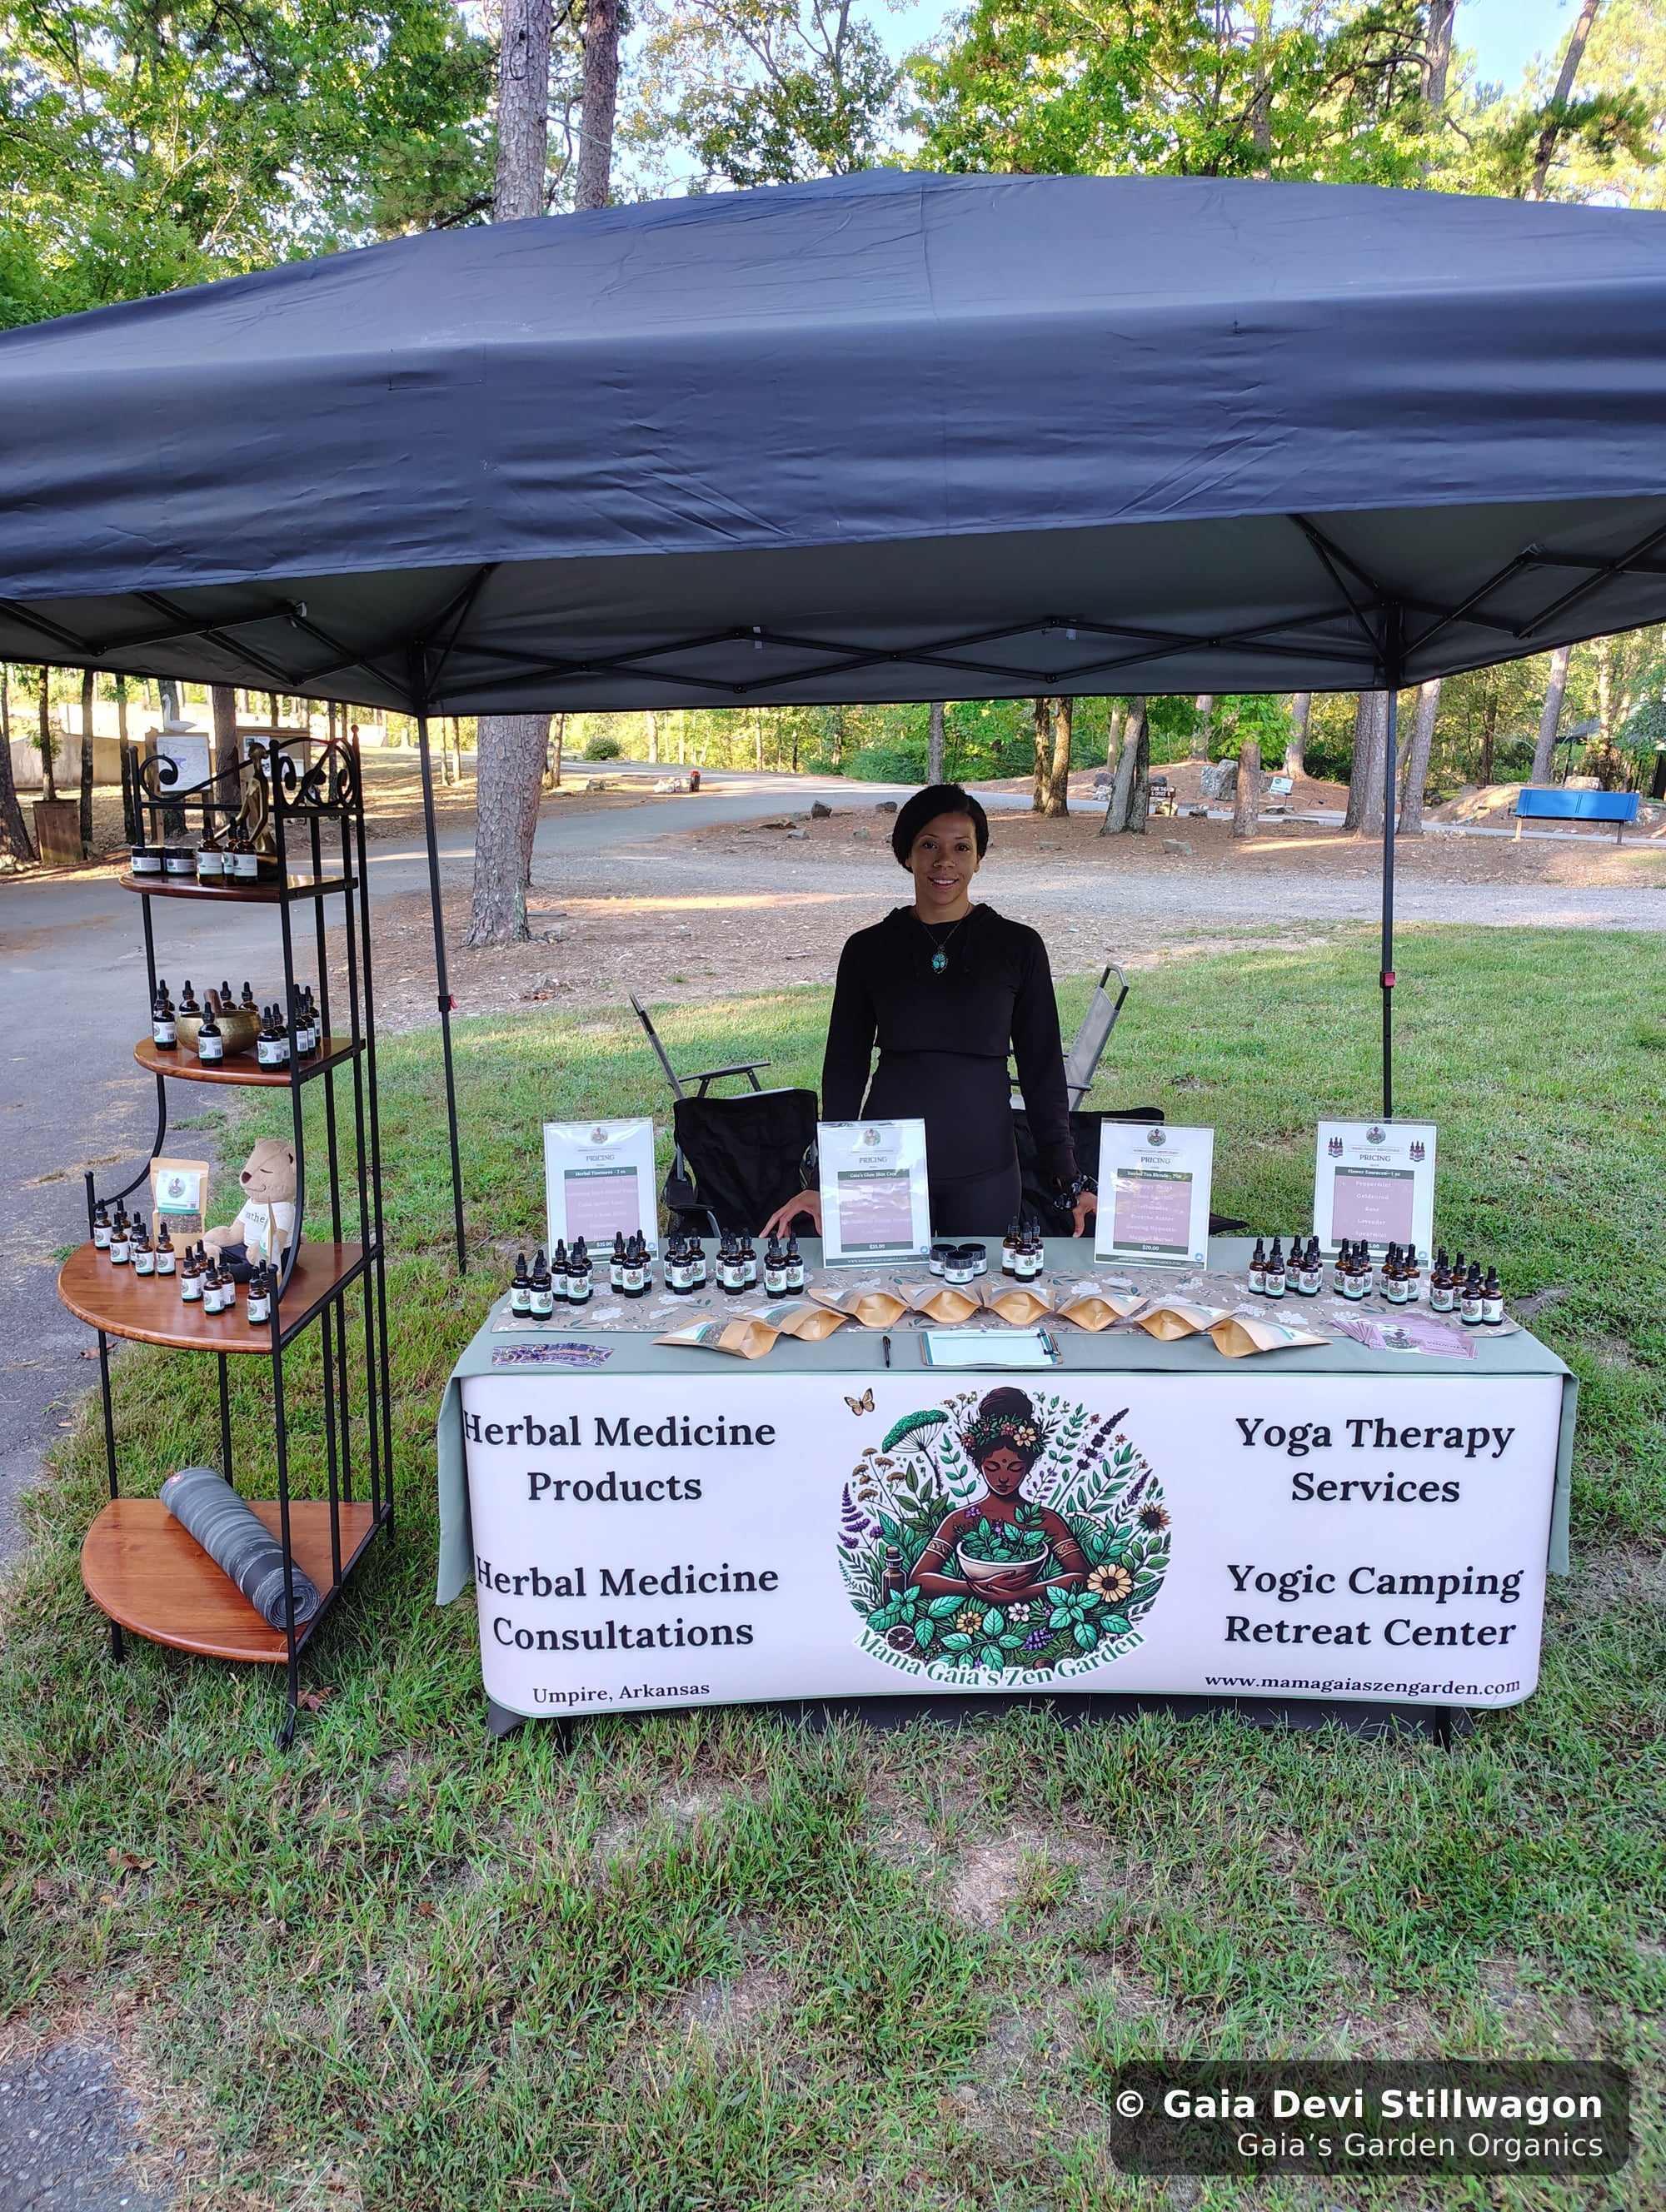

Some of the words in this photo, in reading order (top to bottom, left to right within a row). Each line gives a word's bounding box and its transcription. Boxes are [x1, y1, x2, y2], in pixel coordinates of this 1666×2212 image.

[1140, 1156, 1171, 1164] PRICING
[1355, 1230, 1387, 1238] Spearmint
[463, 1409, 581, 1447] Herbal
[594, 1415, 776, 1447] Medicine
[1235, 1417, 1333, 1457] Yoga
[1345, 1417, 1516, 1458] Therapy
[527, 1471, 703, 1502] Products
[1291, 1471, 1461, 1502] Services
[476, 1554, 587, 1597] Herbal
[599, 1562, 780, 1597] Medicine
[1226, 1564, 1336, 1602] Yogic
[1348, 1566, 1524, 1604] Camping
[493, 1617, 755, 1651] Consultations
[1224, 1616, 1372, 1646] Retreat
[1384, 1618, 1517, 1647] Center
[854, 1627, 920, 1676] Mama
[927, 1661, 999, 1687] Gaia's
[1005, 1667, 1053, 1687] Zen
[1057, 1631, 1145, 1679] Garden
[533, 1686, 613, 1706] Umpire,
[619, 1684, 711, 1701] Arkansas
[1205, 1675, 1521, 1696] www.mamagaiaszengarden.com
